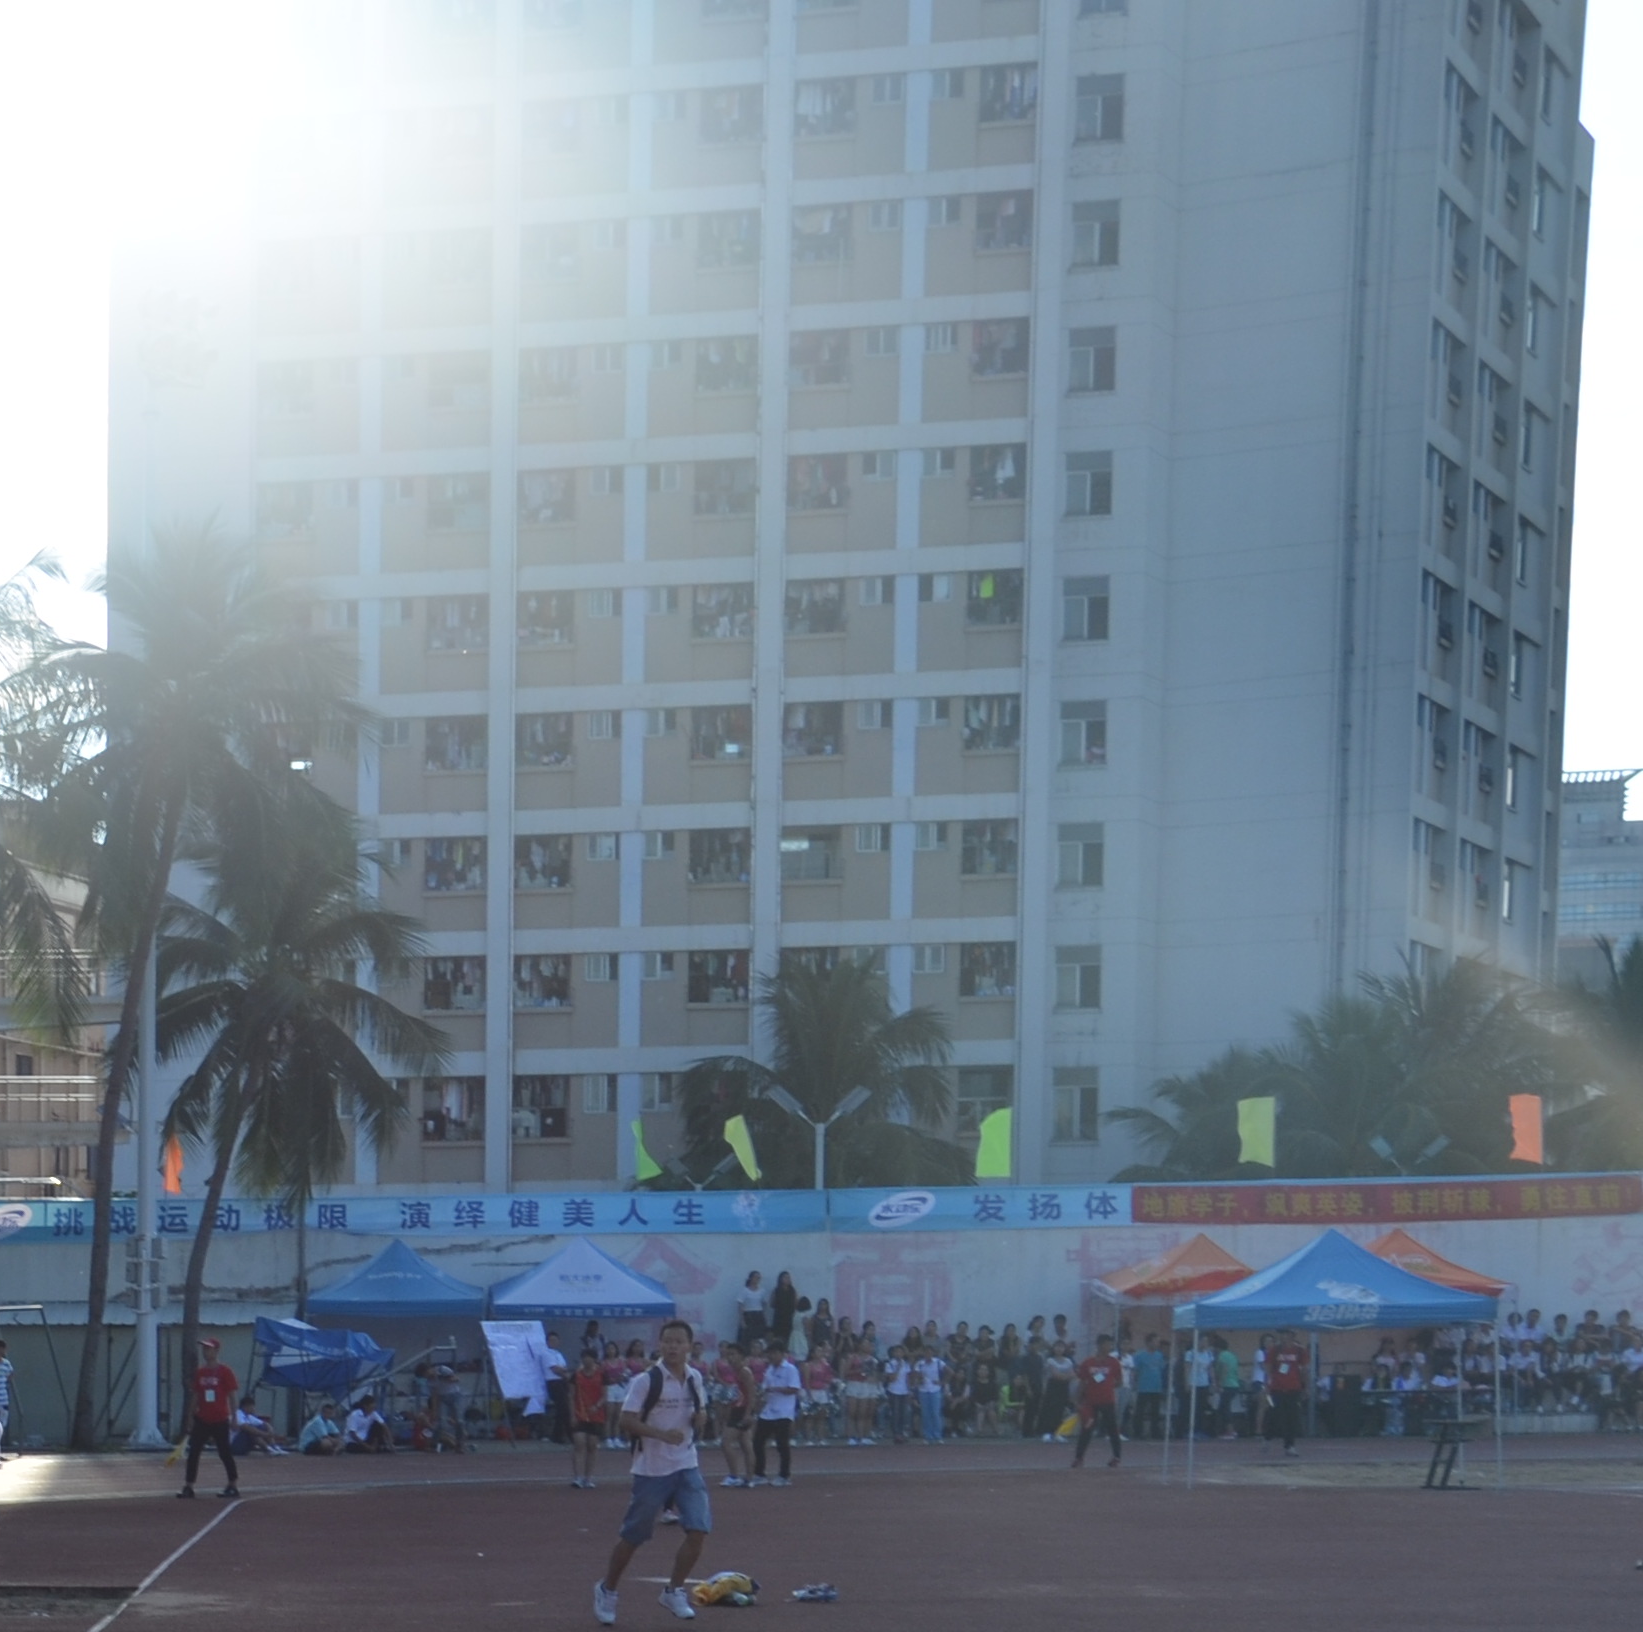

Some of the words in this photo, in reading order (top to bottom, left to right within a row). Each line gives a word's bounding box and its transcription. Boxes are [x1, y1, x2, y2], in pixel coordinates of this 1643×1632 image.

[400, 1198, 706, 1230] 演绎健美人生
[973, 1191, 1119, 1222] 发扬体
